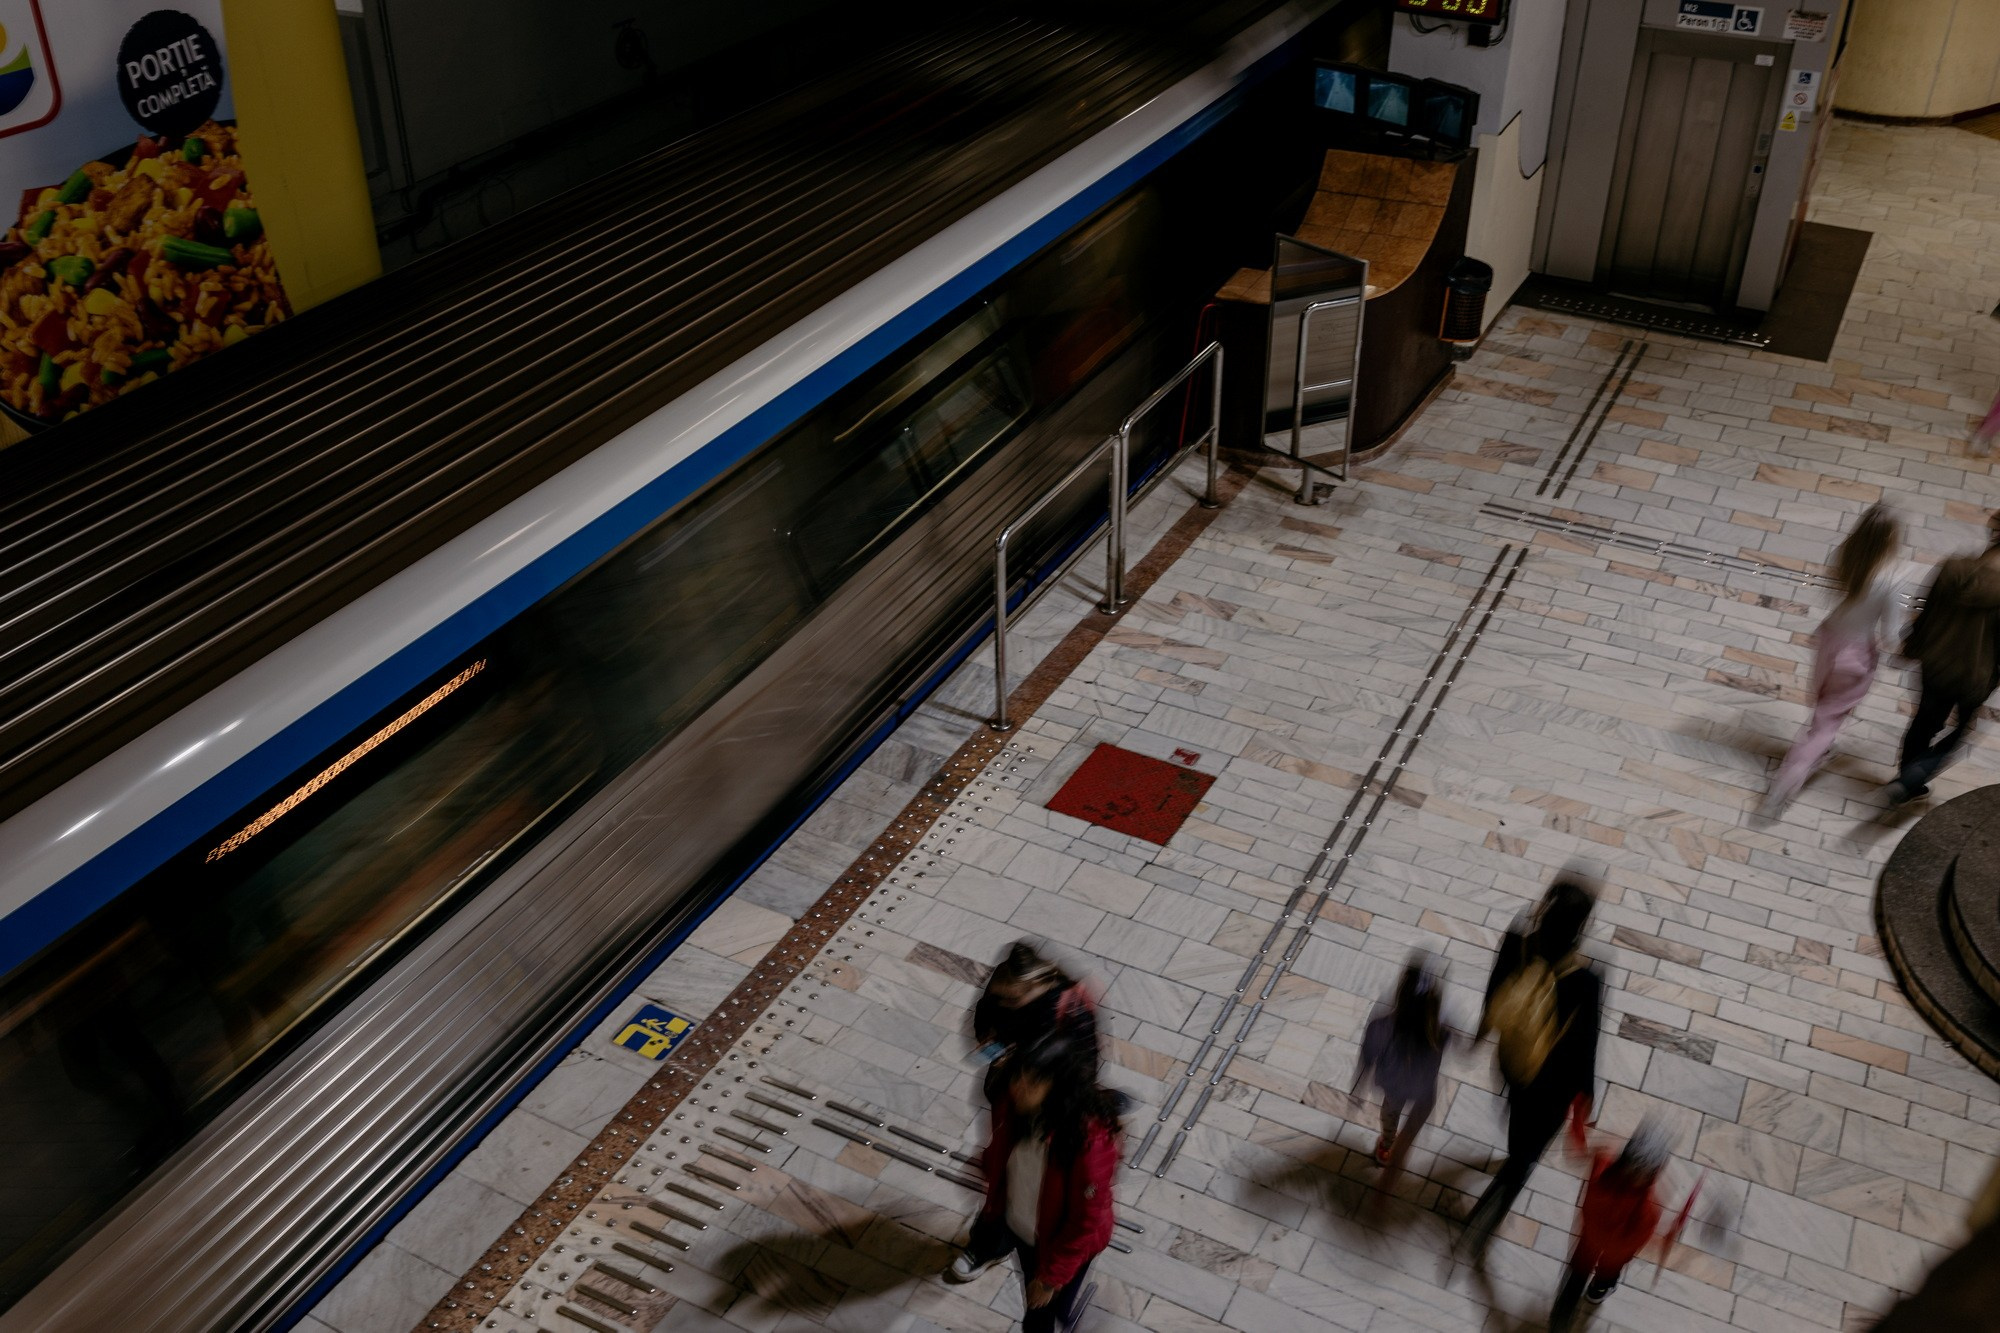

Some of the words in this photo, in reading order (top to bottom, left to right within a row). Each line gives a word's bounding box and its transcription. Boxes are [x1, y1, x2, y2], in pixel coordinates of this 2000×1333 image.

[1679, 15, 1709, 27] Peron
[1683, 3, 1699, 13] M2
[125, 33, 206, 89] PORȚIE
[137, 64, 217, 118] COMPLETĂ
